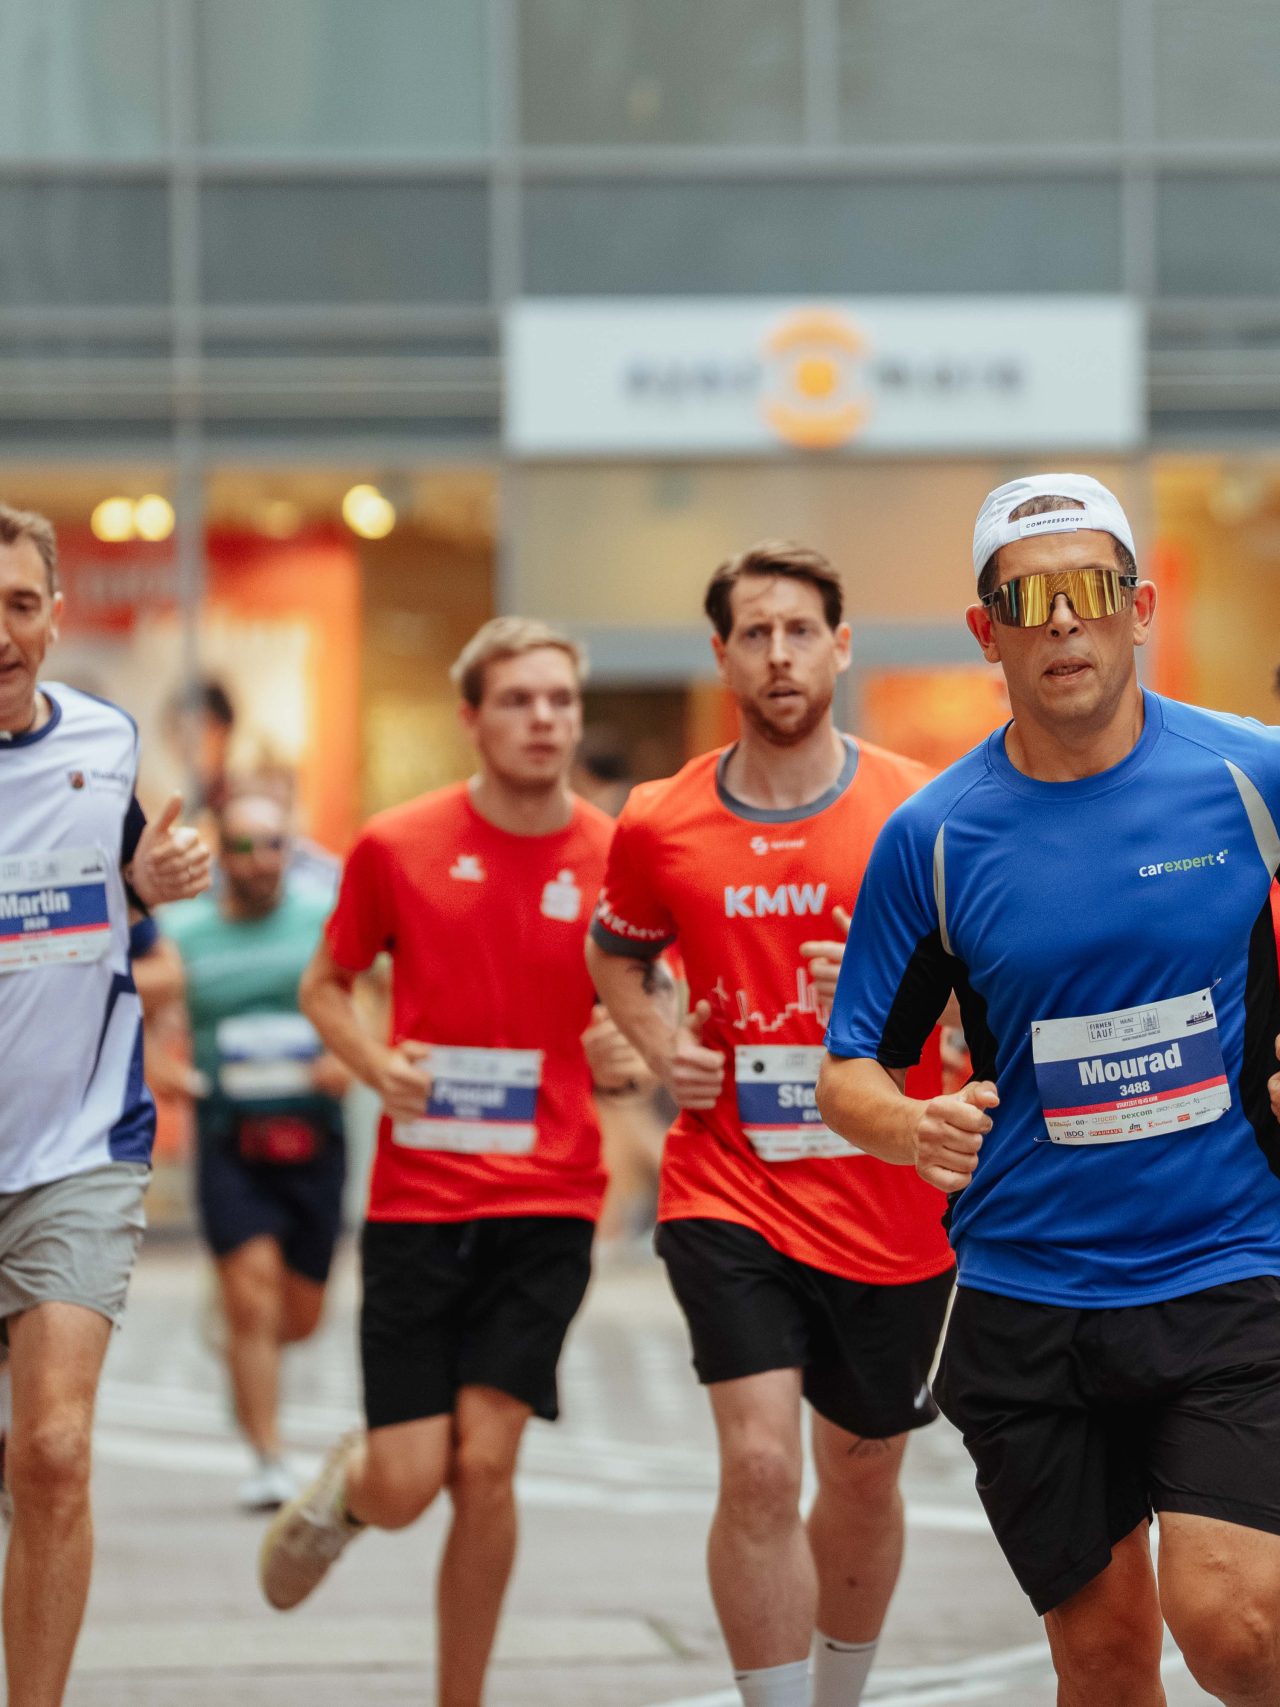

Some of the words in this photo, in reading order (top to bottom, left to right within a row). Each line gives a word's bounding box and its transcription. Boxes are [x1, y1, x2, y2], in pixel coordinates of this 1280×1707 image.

[1025, 517, 1084, 529] COMPRESSPORT
[1138, 853, 1215, 878] carexpert
[0, 888, 70, 919] Martin
[723, 882, 827, 918] KMW
[1089, 1020, 1112, 1030] FIRMEN
[1090, 1028, 1113, 1040] LAUF
[1077, 1042, 1183, 1086] Mourad
[1119, 1080, 1151, 1096] 3488
